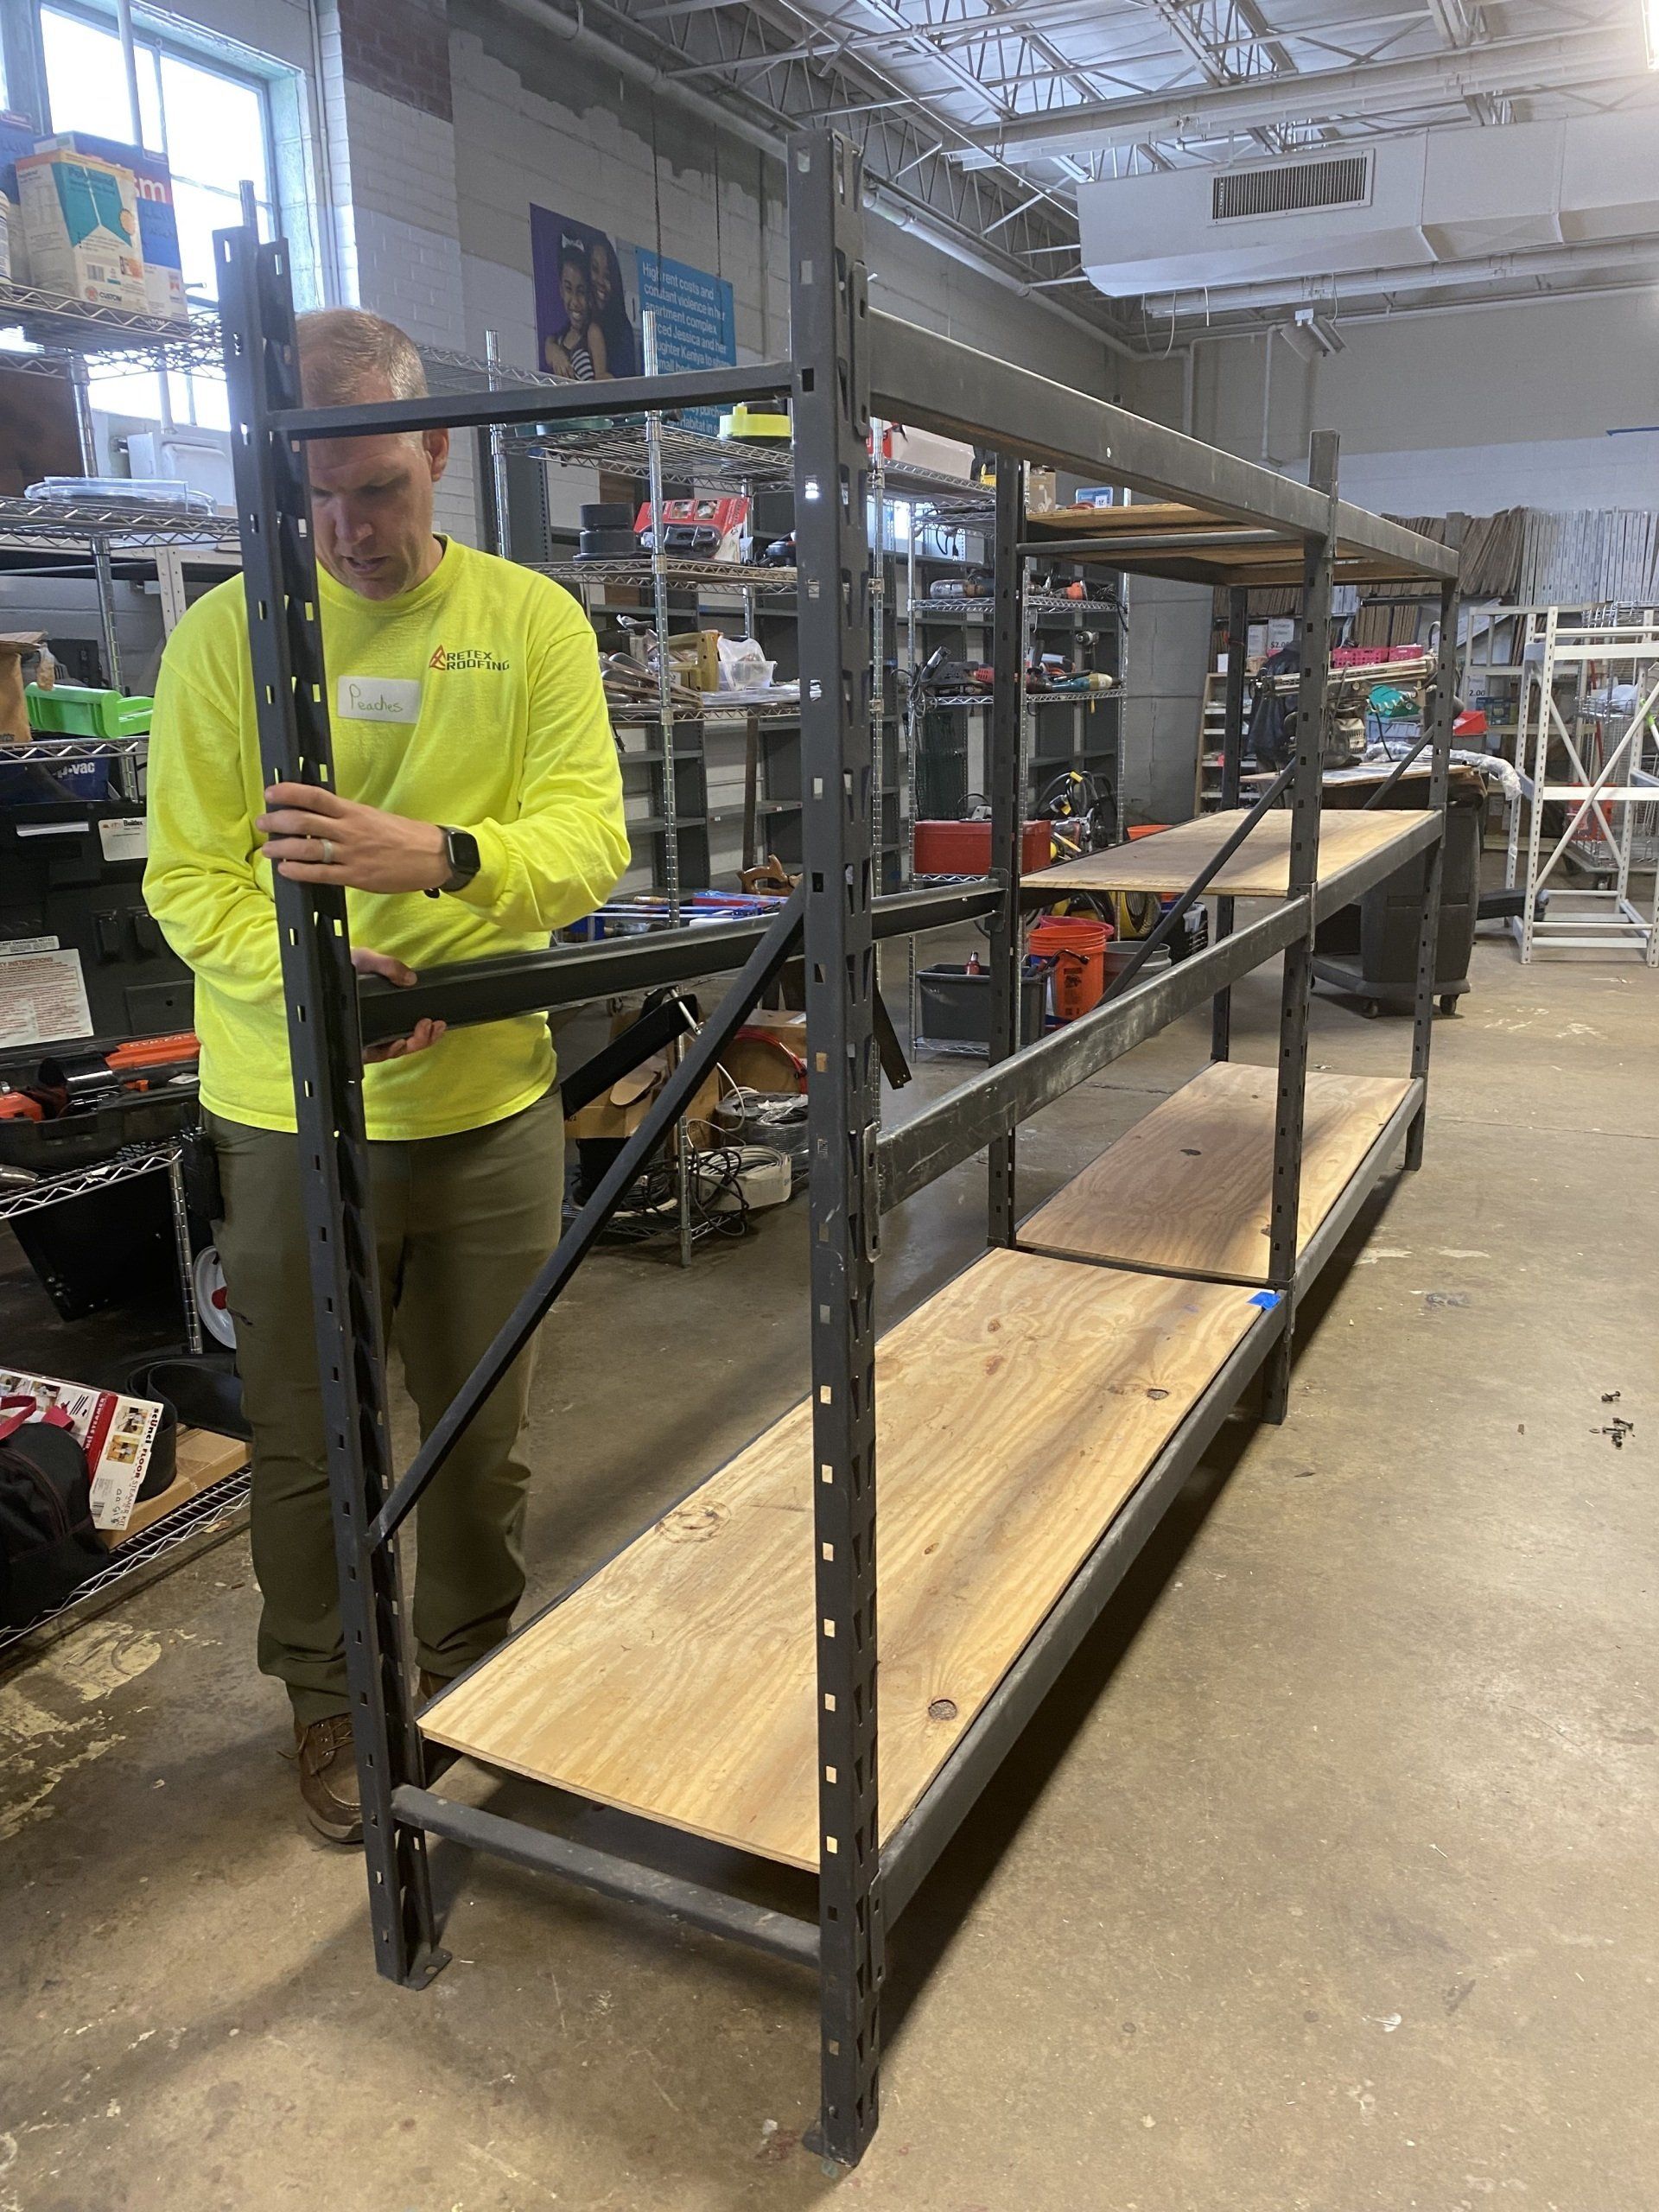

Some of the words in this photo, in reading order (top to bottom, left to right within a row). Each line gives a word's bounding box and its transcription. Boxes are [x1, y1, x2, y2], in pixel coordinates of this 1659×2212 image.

[662, 273, 678, 288] rent
[679, 278, 701, 296] costs
[701, 286, 715, 301] and
[677, 295, 708, 315] violence
[707, 303, 715, 318] in
[686, 315, 718, 335] complex
[657, 323, 673, 337] ced
[673, 325, 700, 346] Jessica
[701, 334, 714, 351] and
[714, 340, 727, 354] her
[657, 340, 680, 357] ughter
[658, 359, 676, 372] mall
[446, 659, 510, 671] ROOFING
[349, 683, 404, 713] Peaches
[135, 1448, 148, 1478] FLOOR
[123, 1480, 138, 1514] STEAMER
